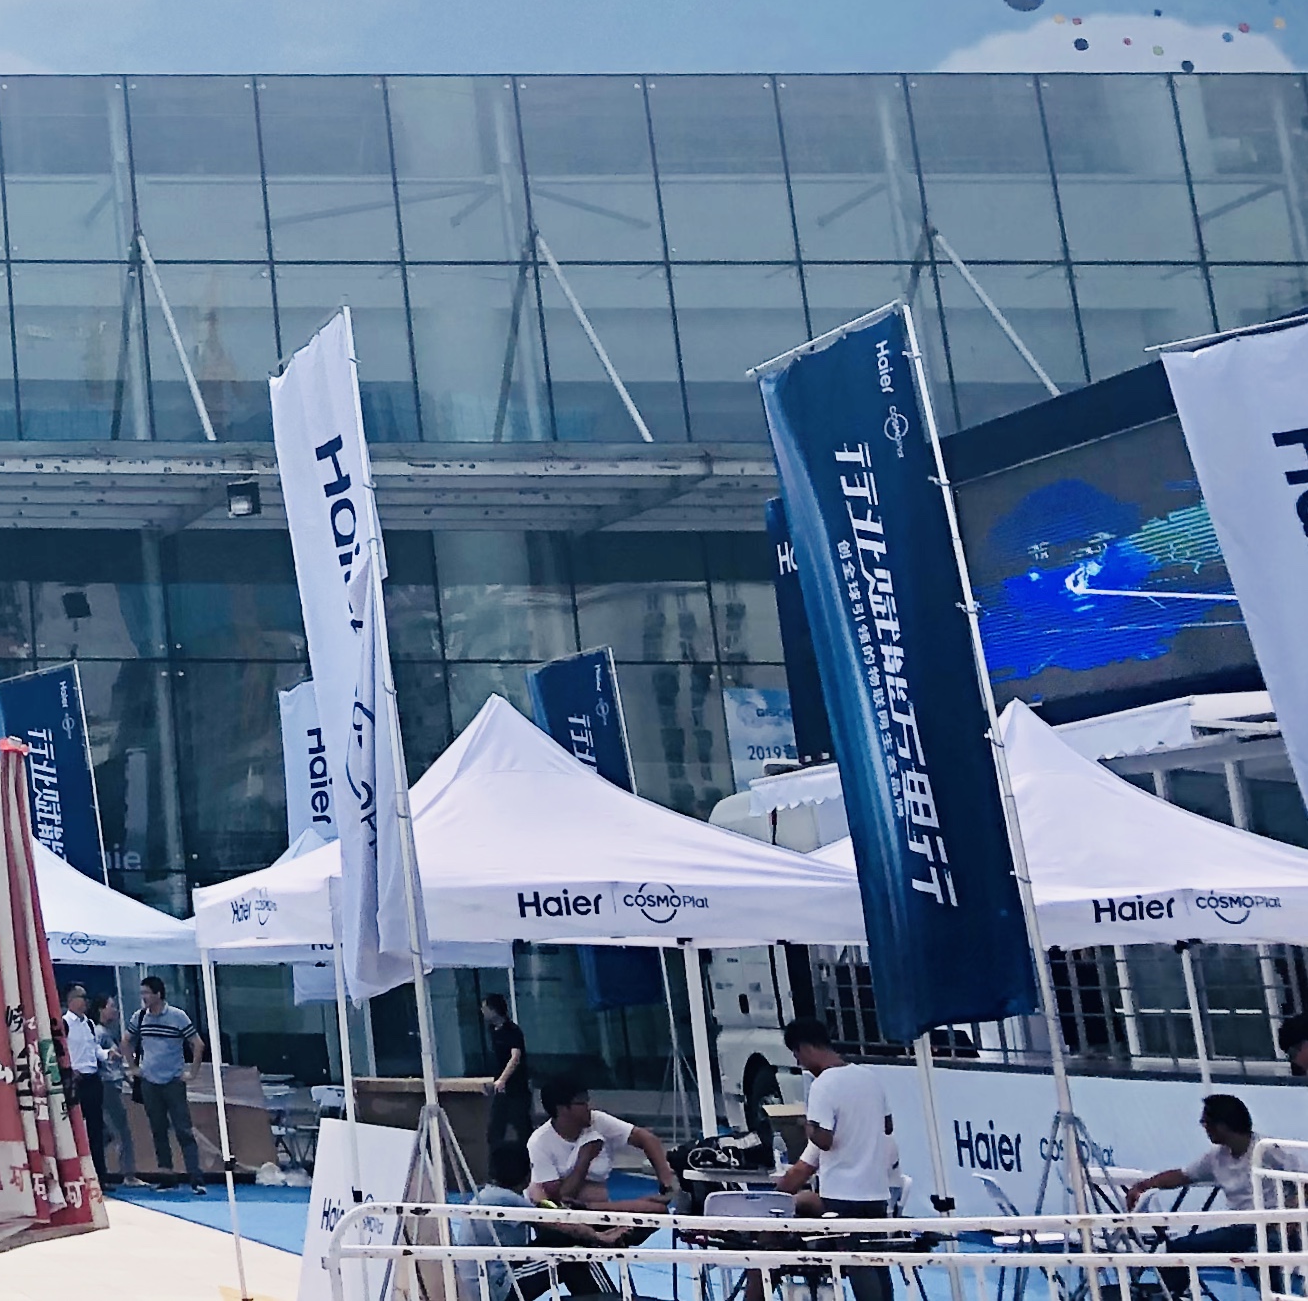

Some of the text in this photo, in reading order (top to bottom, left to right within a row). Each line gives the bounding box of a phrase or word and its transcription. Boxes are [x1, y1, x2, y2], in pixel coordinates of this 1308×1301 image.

[875, 339, 895, 393] Haier
[27, 727, 68, 863] 行业赋能
[306, 726, 333, 825] Haier
[517, 887, 603, 918] Haier
[1092, 894, 1176, 924] Haier
[953, 1119, 1023, 1173] Haier
